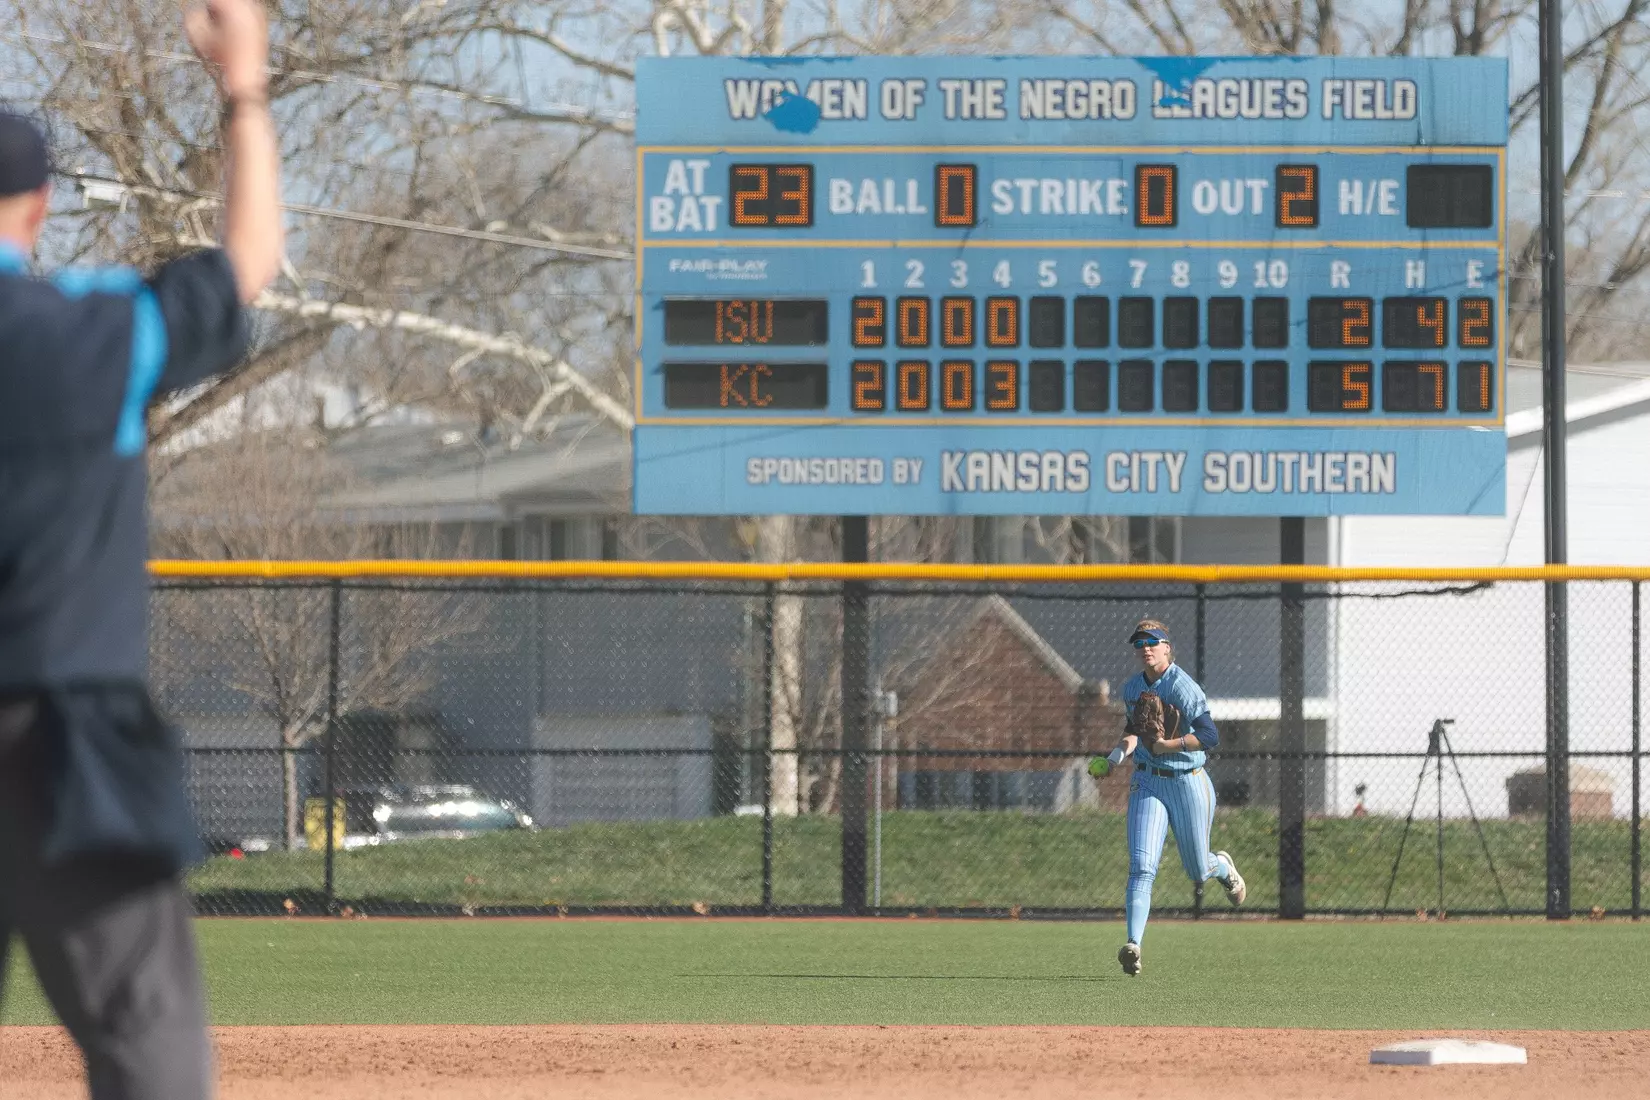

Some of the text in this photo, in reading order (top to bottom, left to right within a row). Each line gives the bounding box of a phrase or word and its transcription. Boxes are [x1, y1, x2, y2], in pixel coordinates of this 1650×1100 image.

[880, 79, 926, 119] OF
[939, 79, 1006, 119] THE
[1020, 79, 1136, 119] NEGRO
[1322, 79, 1417, 120] FIELD
[663, 160, 710, 196] AT
[735, 167, 809, 225] 23
[829, 179, 927, 215] BALL
[939, 167, 972, 225] 0
[991, 179, 1129, 216] STRIKE
[1139, 168, 1173, 225] 0
[1192, 180, 1269, 215] OUT
[1281, 168, 1313, 225] 2
[1338, 180, 1399, 215] H/E
[649, 196, 722, 232] BAT
[861, 260, 1485, 288] 1 2 3 4 5 6 7 8 9 10 R H E
[715, 300, 1489, 345] ISU 2 0 0 0 2 4 2
[719, 363, 1489, 408] KC 2 0 0 3 5 7 1
[747, 451, 1396, 493] SPONSORED BY KANSAS CITY SOUTHERN
